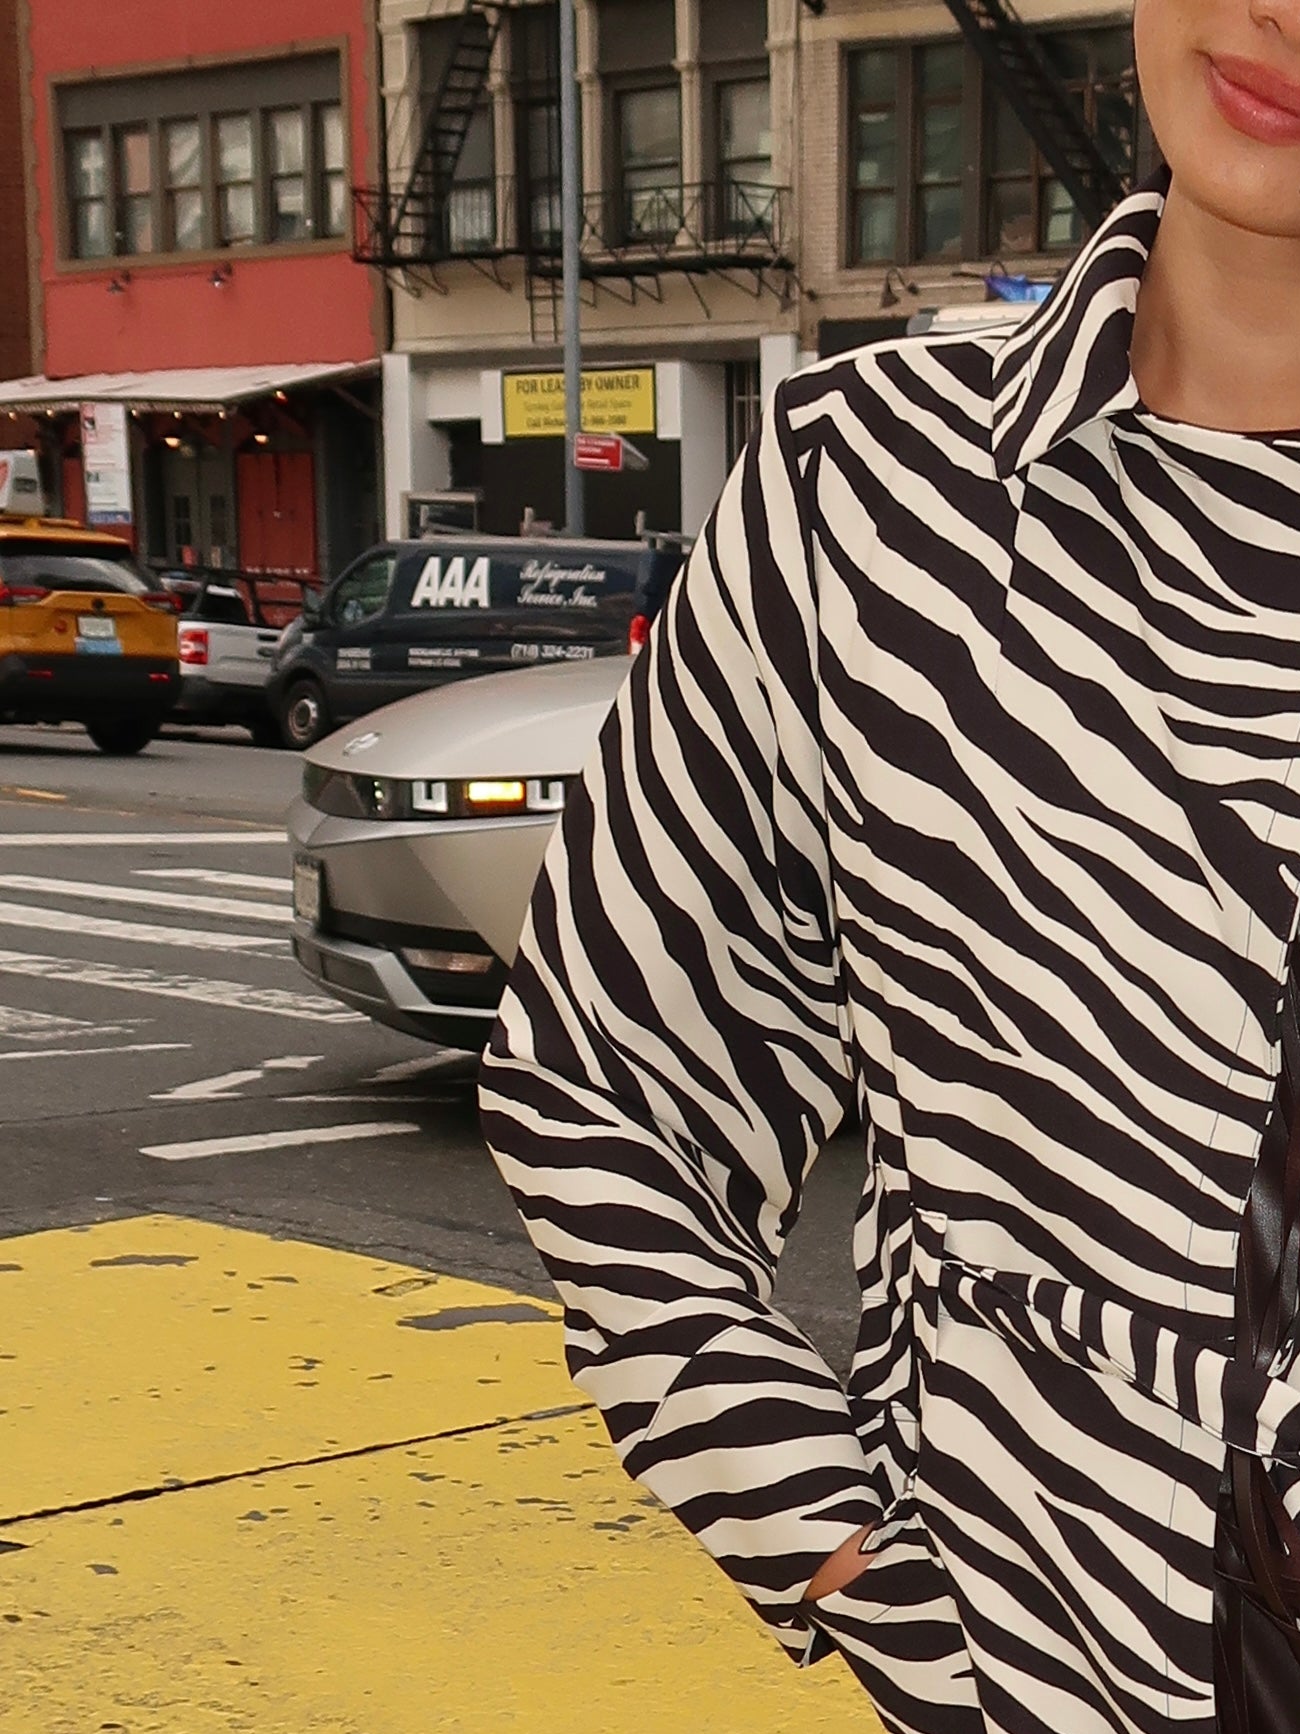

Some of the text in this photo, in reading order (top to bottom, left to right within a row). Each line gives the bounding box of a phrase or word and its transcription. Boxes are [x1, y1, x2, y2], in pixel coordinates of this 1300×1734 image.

[516, 374, 640, 394] FOR LEAS BY OWNER
[411, 556, 490, 608] AAA
[511, 643, 539, 659] (718)
